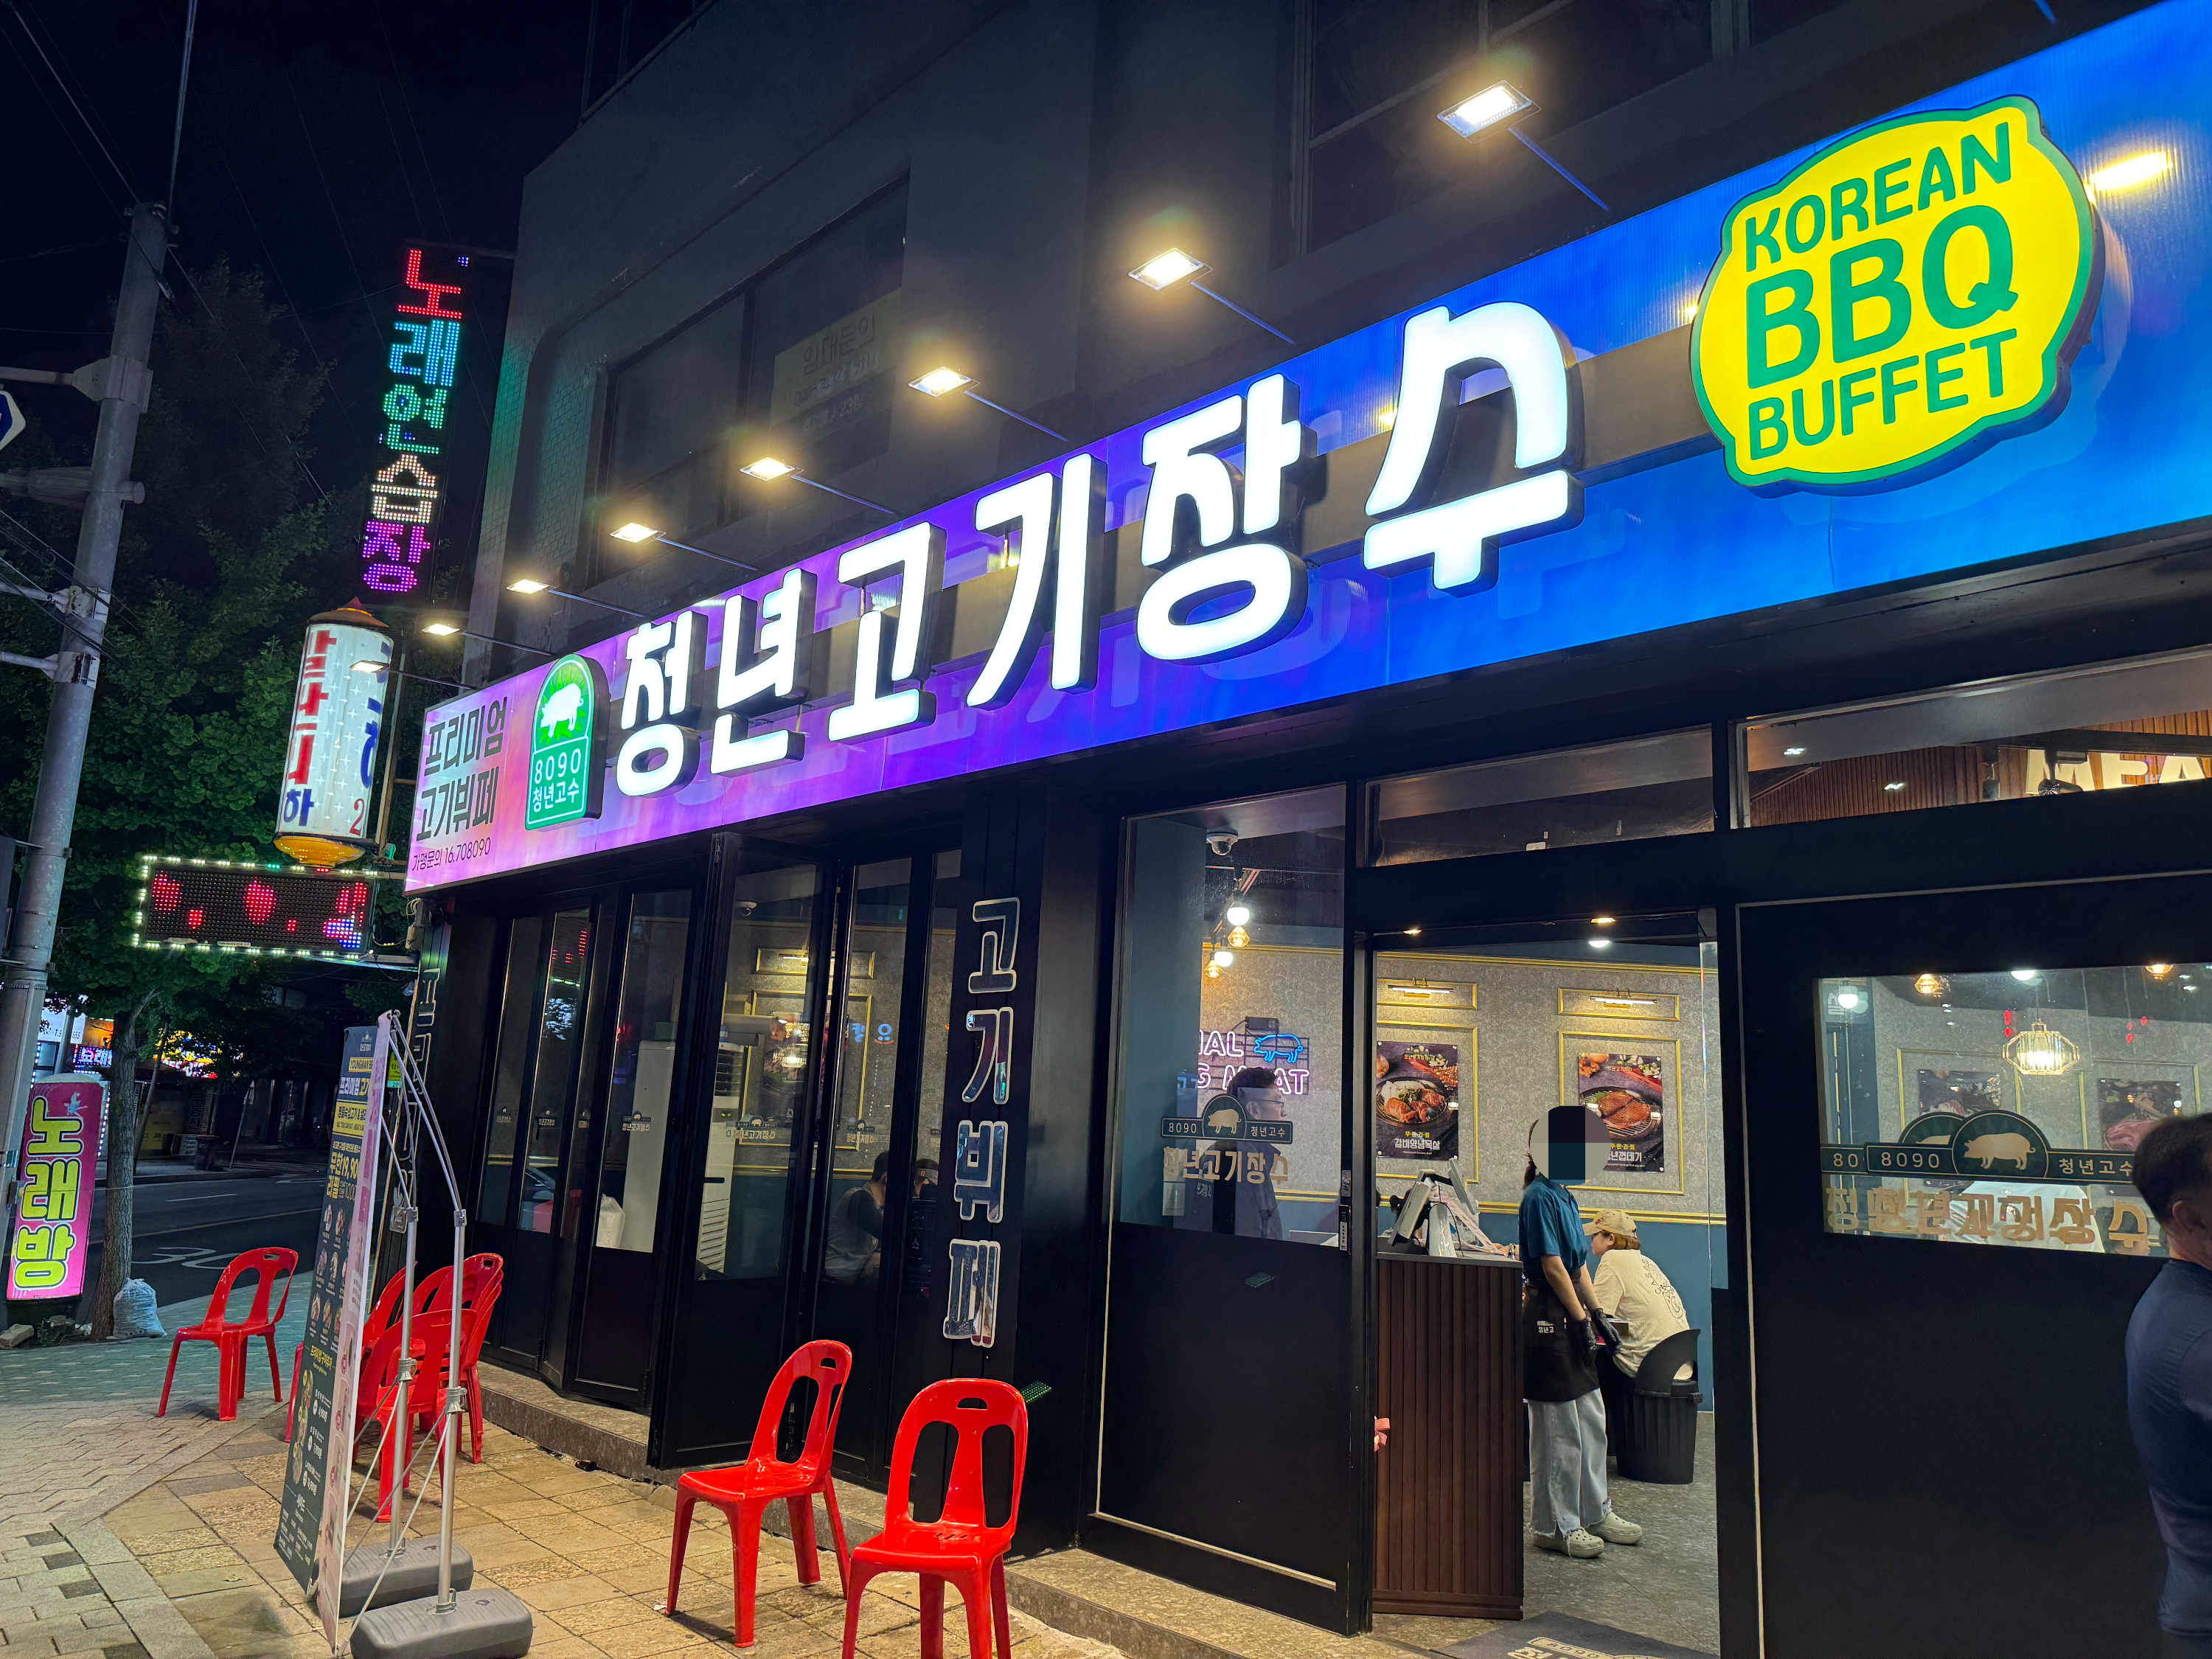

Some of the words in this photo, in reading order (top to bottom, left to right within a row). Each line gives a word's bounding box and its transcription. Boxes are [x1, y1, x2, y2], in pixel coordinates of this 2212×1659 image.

[1745, 121, 2012, 272] KOREAN
[1745, 204, 2019, 389] BBQ
[804, 312, 875, 376] 임대문의
[1747, 327, 2017, 460] BUFFET
[362, 249, 463, 593] 노래연습장
[616, 302, 1569, 797] 청년고기장수
[424, 697, 507, 776] 프리미엄
[534, 748, 581, 784] 8090
[416, 766, 499, 841] 고기뷔페
[532, 777, 580, 812] 청년고수
[412, 848, 442, 871] 가맹문의
[445, 837, 491, 863] 16.708090
[1199, 1030, 1245, 1057] AL
[1222, 1064, 1310, 1095] MAT
[944, 897, 1020, 1349] 고기뷔페
[1168, 1122, 1197, 1134] 8090
[1251, 1126, 1285, 1138] 청년고수
[1394, 1138, 1441, 1150] 갈비양념목살
[1607, 1150, 1642, 1163] 년껍데기
[1880, 1151, 1941, 1169] 8090
[330, 1152, 344, 1175] 무한
[1164, 1147, 1289, 1185] 청년고기장수
[2058, 1158, 2133, 1178] 청년고수
[13, 1096, 83, 1290] 노래방
